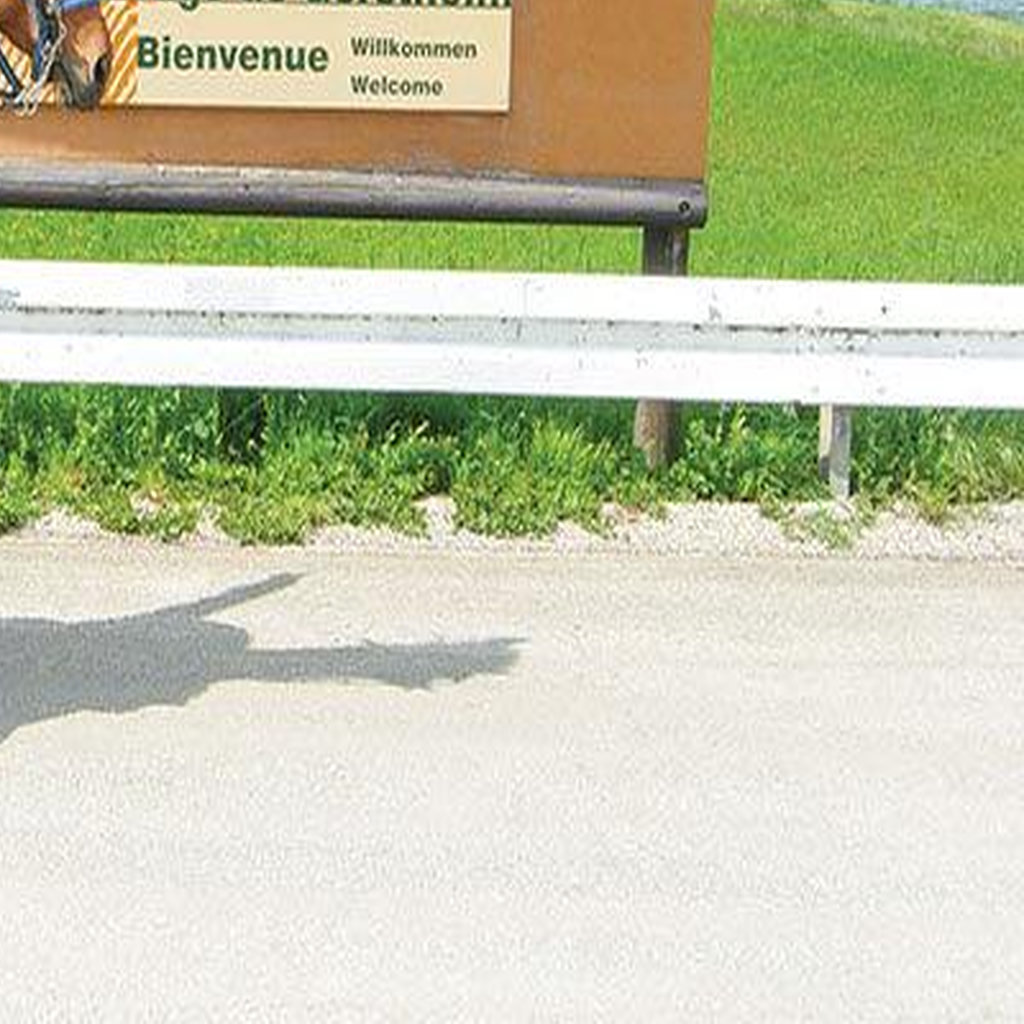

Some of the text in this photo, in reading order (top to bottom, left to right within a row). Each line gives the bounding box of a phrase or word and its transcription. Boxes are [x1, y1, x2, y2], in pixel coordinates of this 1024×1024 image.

[138, 35, 329, 72] Bienvenue
[350, 37, 477, 59] Willkommen
[350, 75, 443, 96] Welcome
